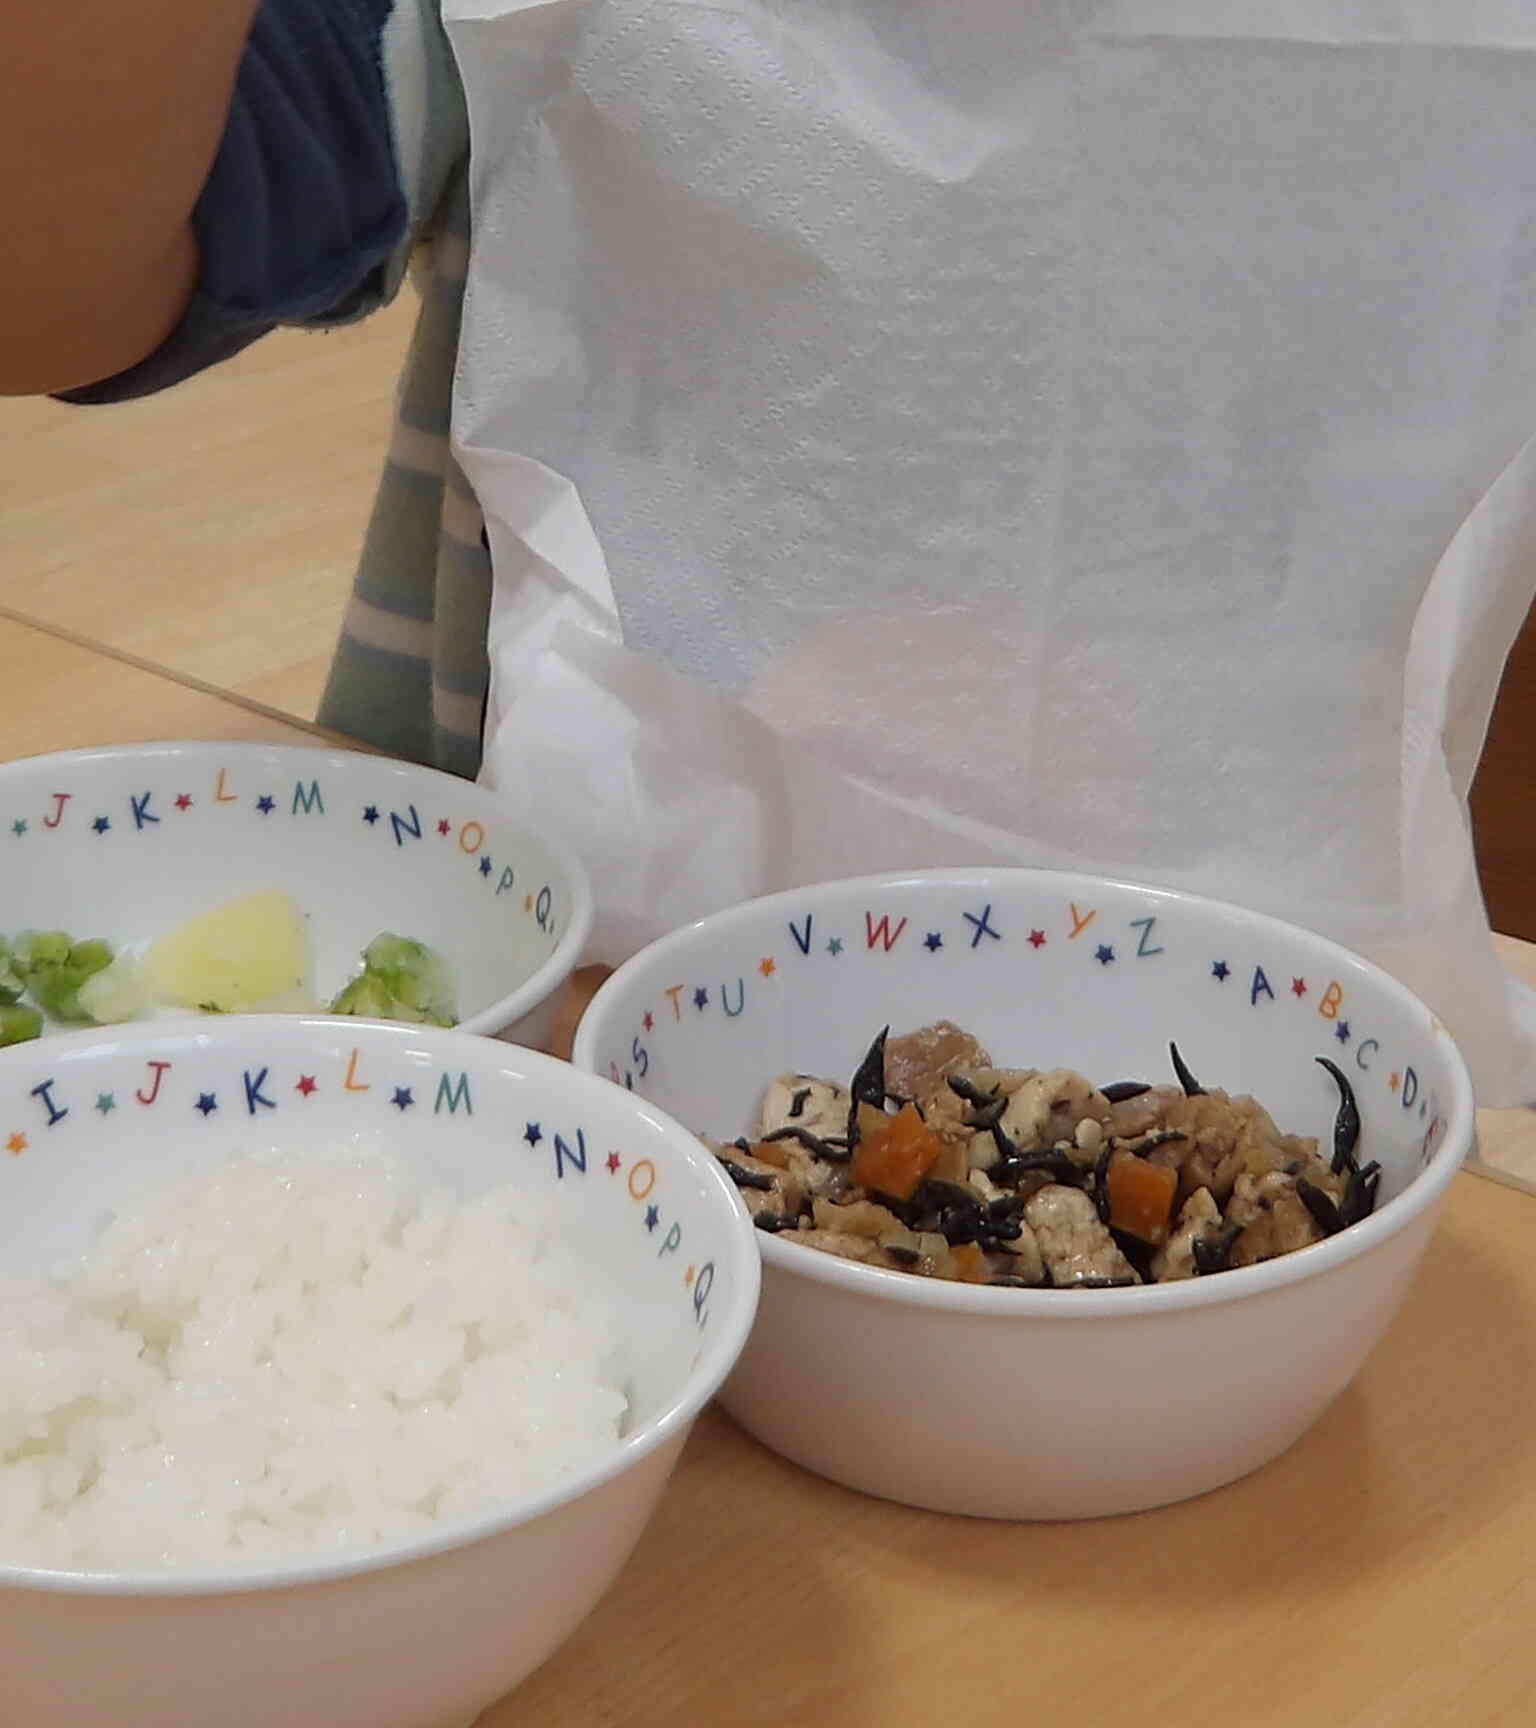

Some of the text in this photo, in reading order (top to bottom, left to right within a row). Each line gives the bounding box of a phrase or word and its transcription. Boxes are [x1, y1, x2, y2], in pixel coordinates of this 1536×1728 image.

[44, 794, 71, 828] J
[131, 792, 160, 830] K
[216, 769, 237, 802] L
[292, 781, 324, 815] M
[389, 805, 422, 846] N
[459, 823, 484, 854] O
[536, 886, 551, 932] Q
[666, 985, 684, 1021] T
[722, 979, 744, 1016] U
[790, 914, 812, 954] V
[866, 911, 907, 952] W
[964, 904, 1000, 947] X
[1069, 904, 1096, 939] Y
[1131, 918, 1163, 956] Z
[1252, 966, 1274, 1005] A
[1320, 982, 1343, 1019] B
[1357, 1040, 1378, 1069] C
[1403, 1068, 1417, 1108] D
[31, 1080, 68, 1126] I
[137, 1062, 171, 1104] J
[244, 1067, 276, 1114] K
[345, 1049, 369, 1091] L
[435, 1073, 472, 1114] M
[554, 1128, 586, 1178] N
[629, 1160, 655, 1199] O
[659, 1223, 680, 1256] P
